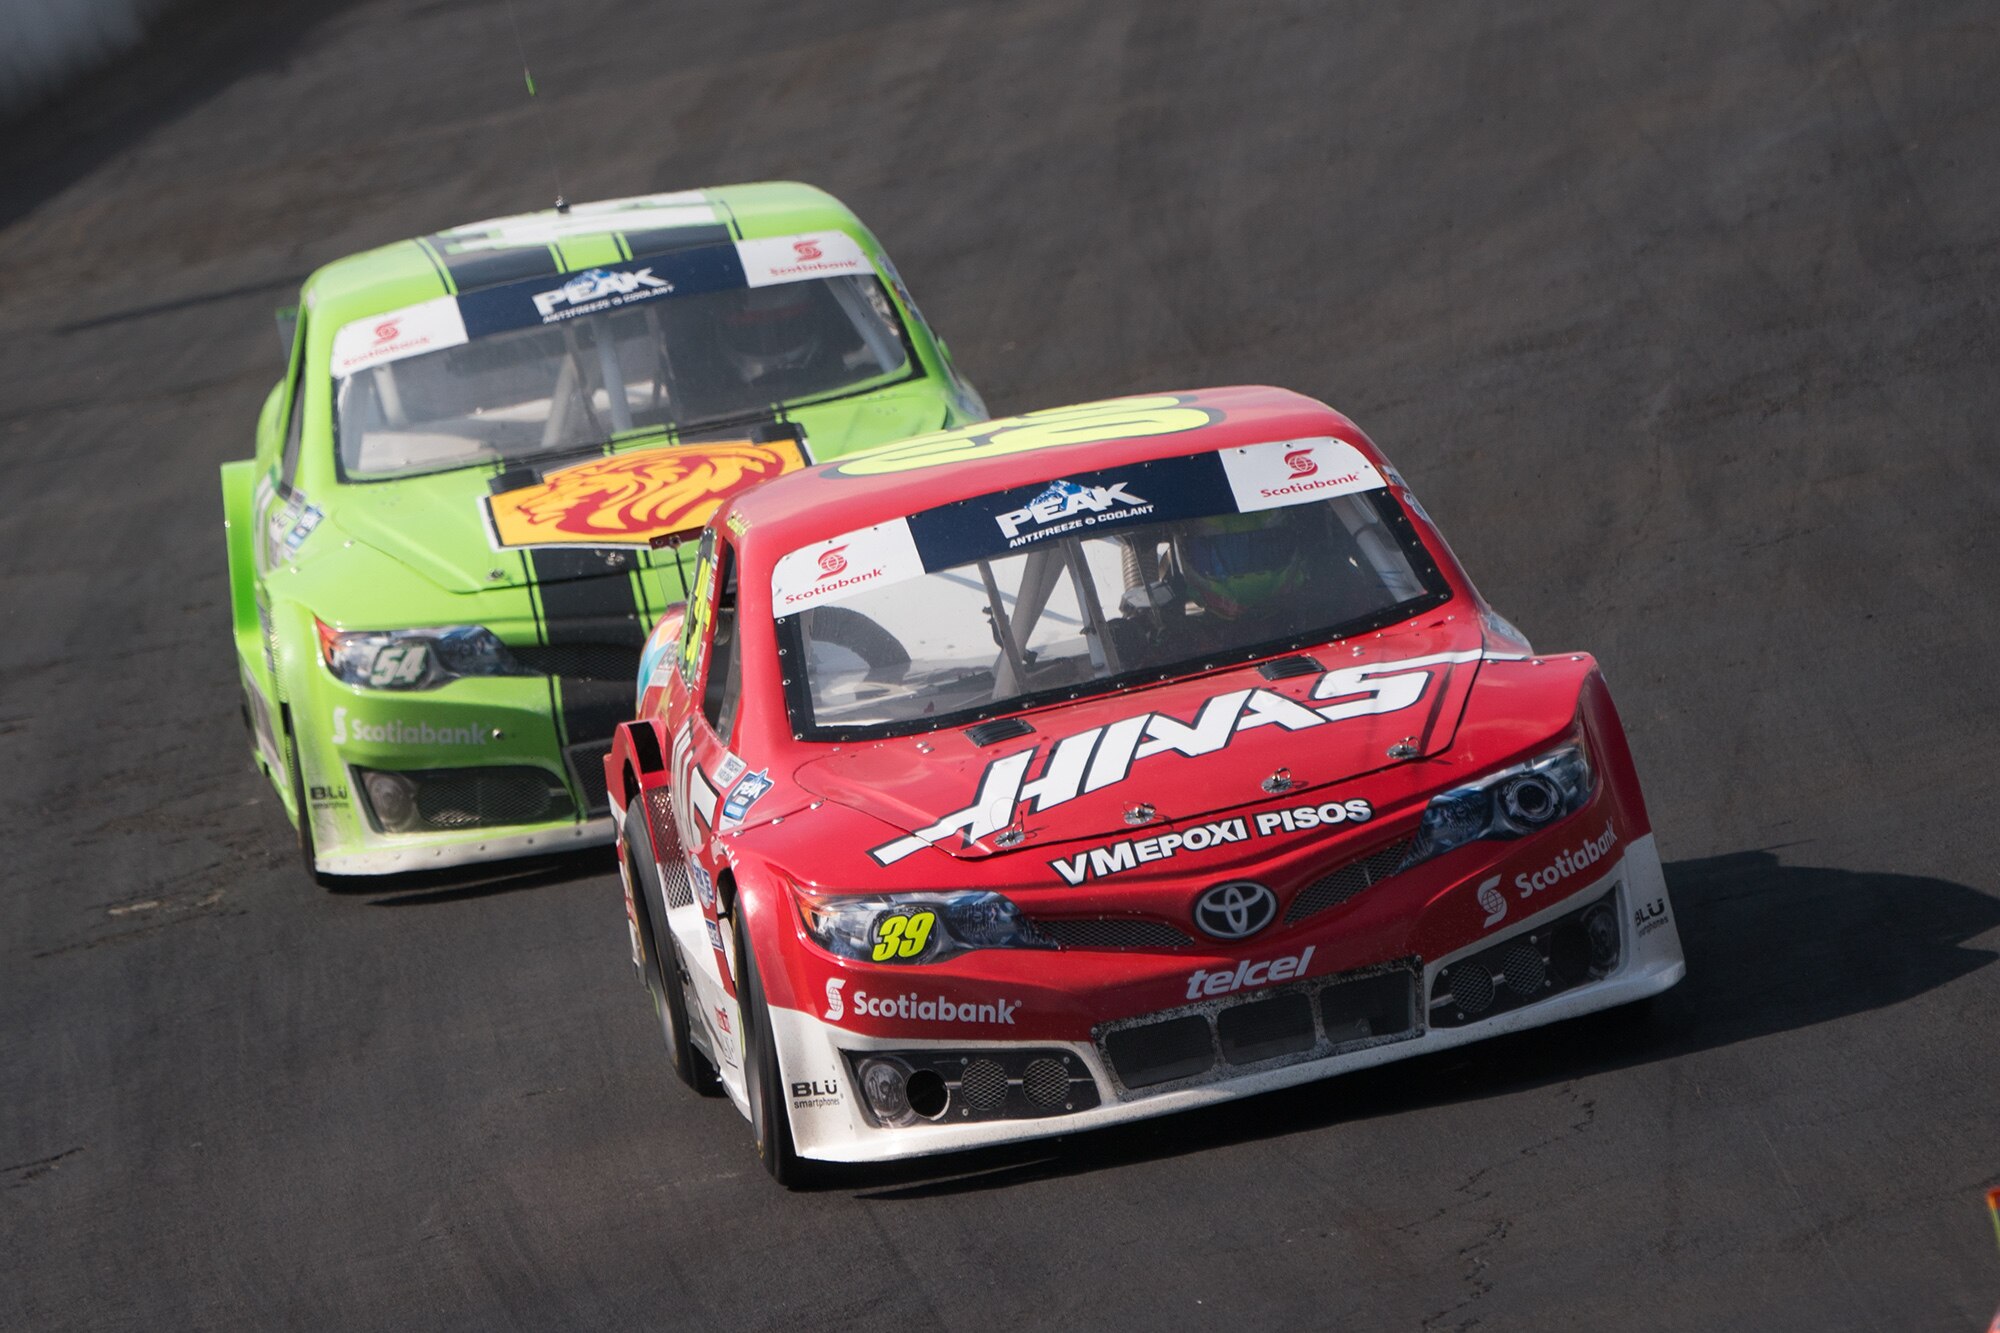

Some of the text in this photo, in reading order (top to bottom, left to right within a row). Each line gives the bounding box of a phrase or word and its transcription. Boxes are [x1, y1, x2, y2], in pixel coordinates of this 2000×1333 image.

[532, 267, 669, 316] PEAK
[1260, 473, 1358, 498] Scotiabank
[995, 481, 1148, 539] PEAK
[1009, 519, 1083, 548] ANTIFREEZE
[1097, 504, 1154, 522] COOLANT
[784, 567, 883, 604] Scotiabank
[369, 645, 428, 686] 54
[352, 718, 487, 745] Scotiabank
[1050, 799, 1374, 887] VMEPOXI PISOS
[1514, 818, 1618, 900] Scotiabank
[871, 911, 937, 962] 39
[1187, 945, 1317, 1001] telcel
[854, 990, 1016, 1025] Scotiabank
